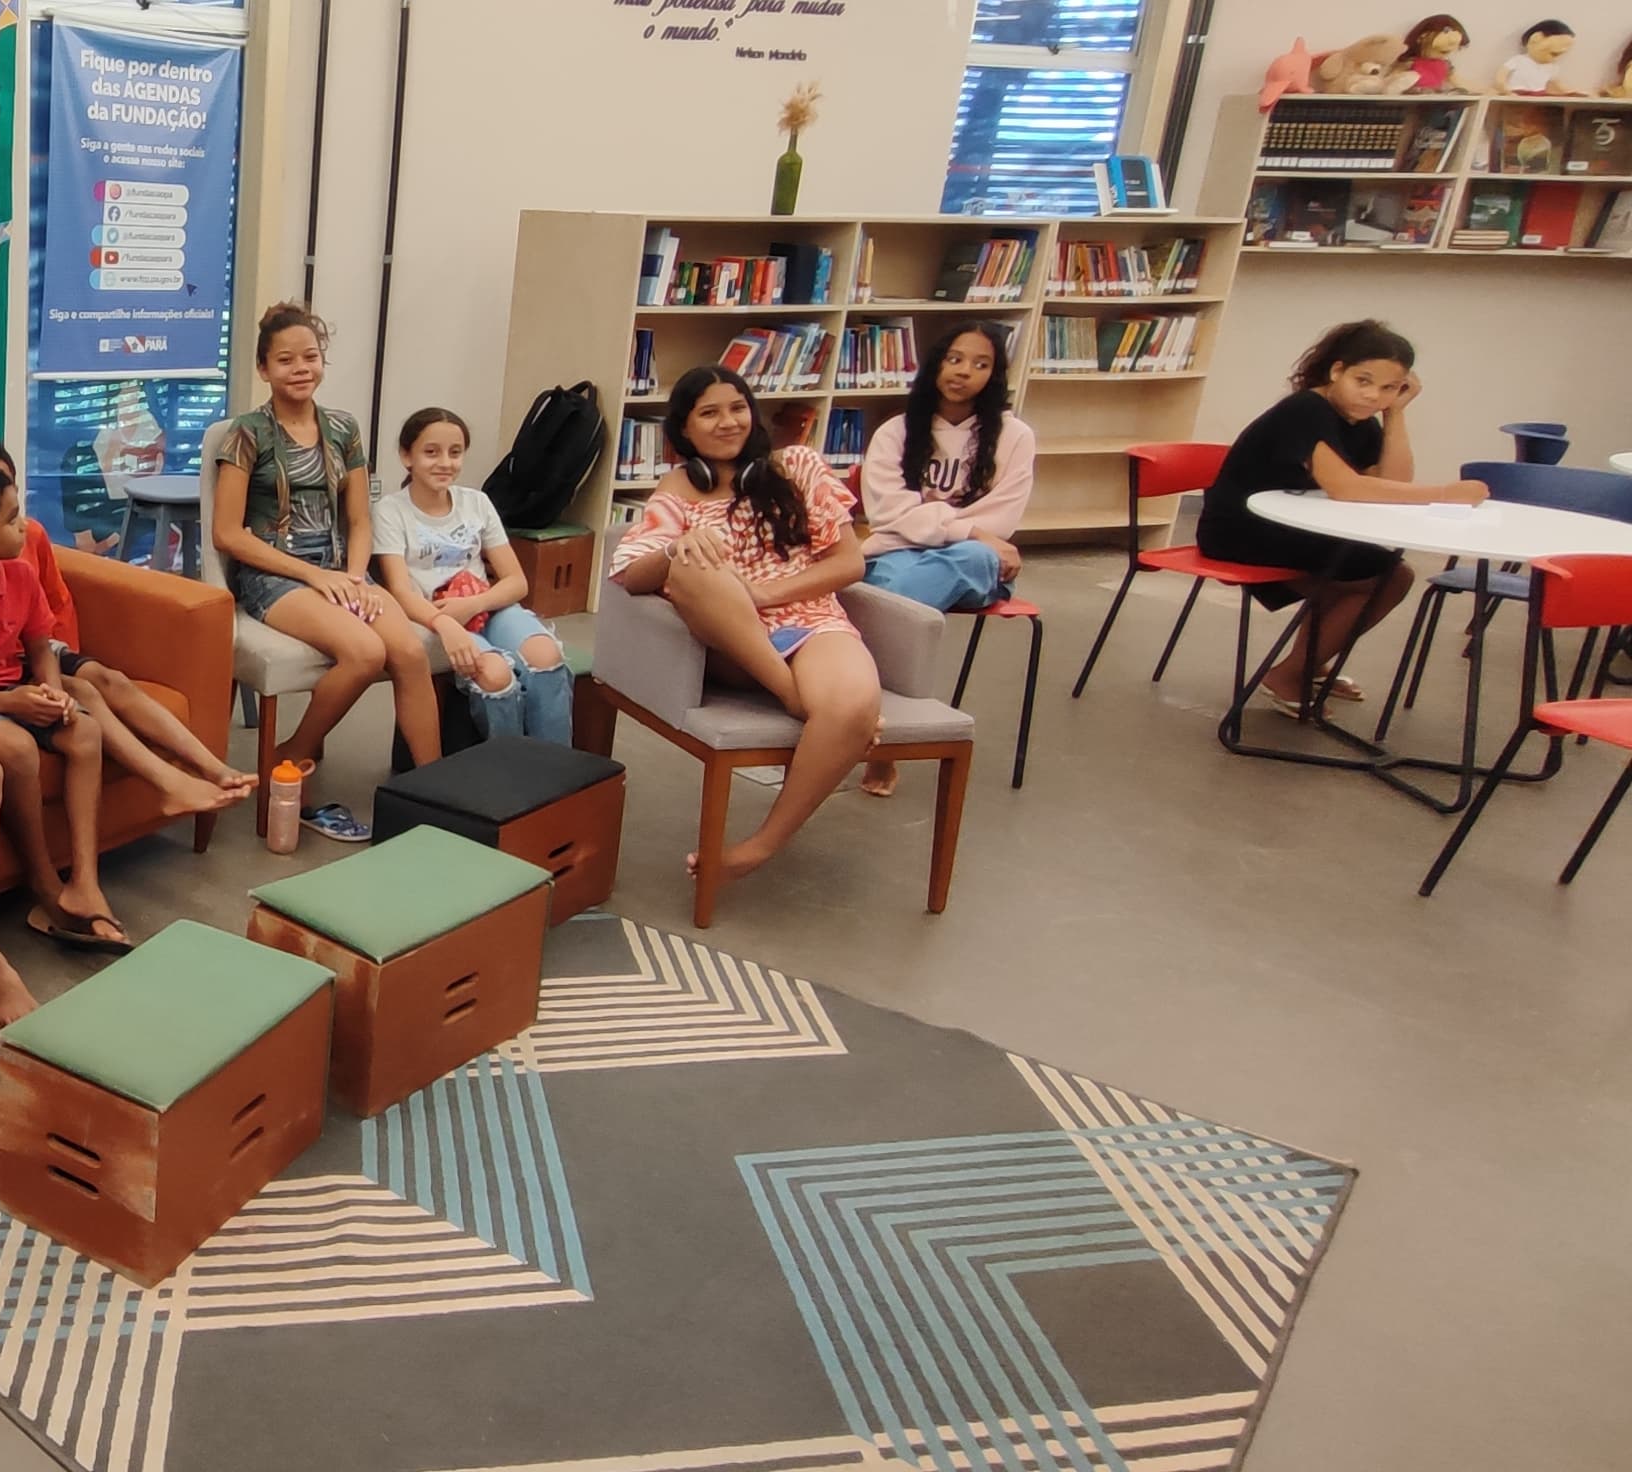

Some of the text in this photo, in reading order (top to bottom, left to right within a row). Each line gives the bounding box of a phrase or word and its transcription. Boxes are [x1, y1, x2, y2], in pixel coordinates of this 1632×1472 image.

[735, 0, 784, 18] para
[791, 0, 845, 16] mudar
[643, 24, 656, 39] o
[80, 49, 213, 82] Fique por dentro
[91, 77, 201, 106] das AGENDAS
[87, 101, 207, 132] da FUNDAÇÃO!
[80, 138, 102, 152] Siga
[103, 141, 109, 150] a
[137, 144, 152, 154] nas
[153, 144, 178, 156] redes
[179, 146, 205, 158] sociais
[49, 308, 69, 322] Siga
[70, 311, 76, 319] e
[78, 308, 131, 323] compartilhe
[132, 308, 183, 322] informações
